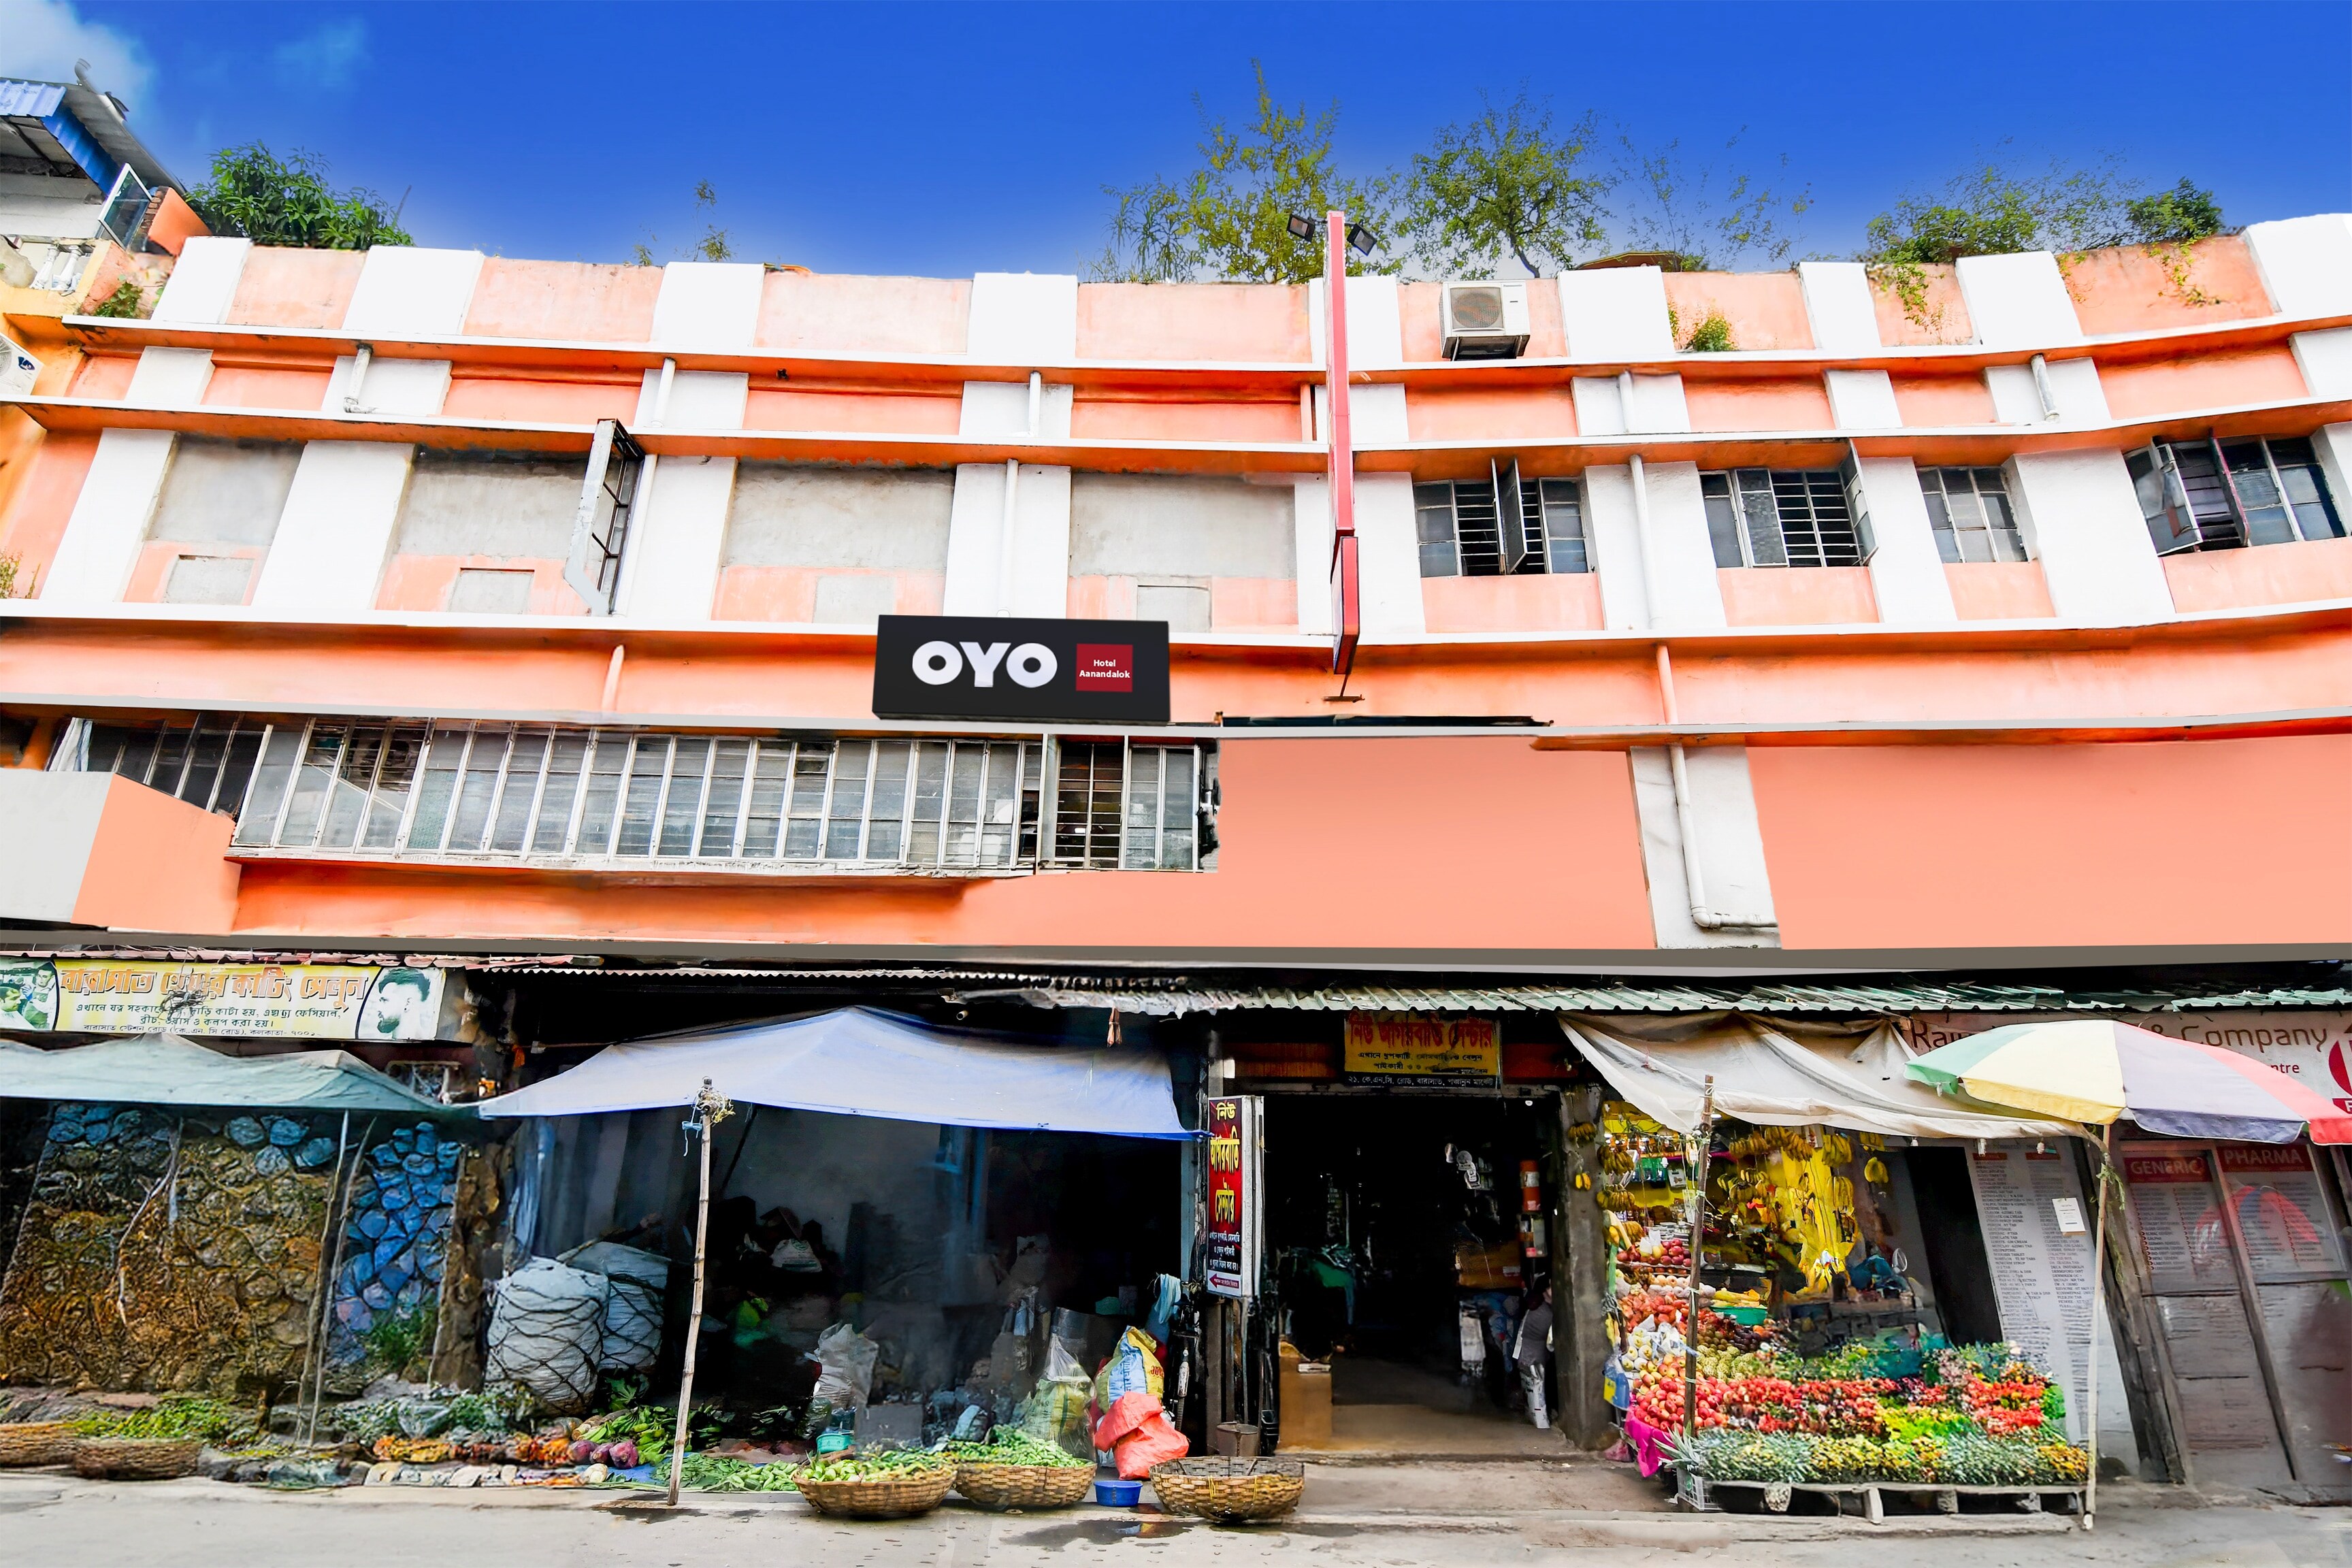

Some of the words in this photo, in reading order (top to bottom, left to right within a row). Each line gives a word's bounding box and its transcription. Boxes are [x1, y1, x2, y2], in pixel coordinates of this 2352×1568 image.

[912, 640, 1058, 687] OYO
[1093, 659, 1116, 667] Hotel
[1079, 669, 1130, 679] Aanandalok
[61, 968, 157, 996] বারাসাত
[232, 967, 292, 1001] কাটিং
[299, 975, 368, 1013] সেলুন
[76, 1004, 107, 1012] এখানে
[215, 1007, 239, 1016] কাটা
[2181, 1025, 2327, 1053] Company
[1215, 1102, 1237, 1121] নিউ
[2224, 1148, 2304, 1164] PHARMA
[2130, 1160, 2202, 1175] GENERIC
